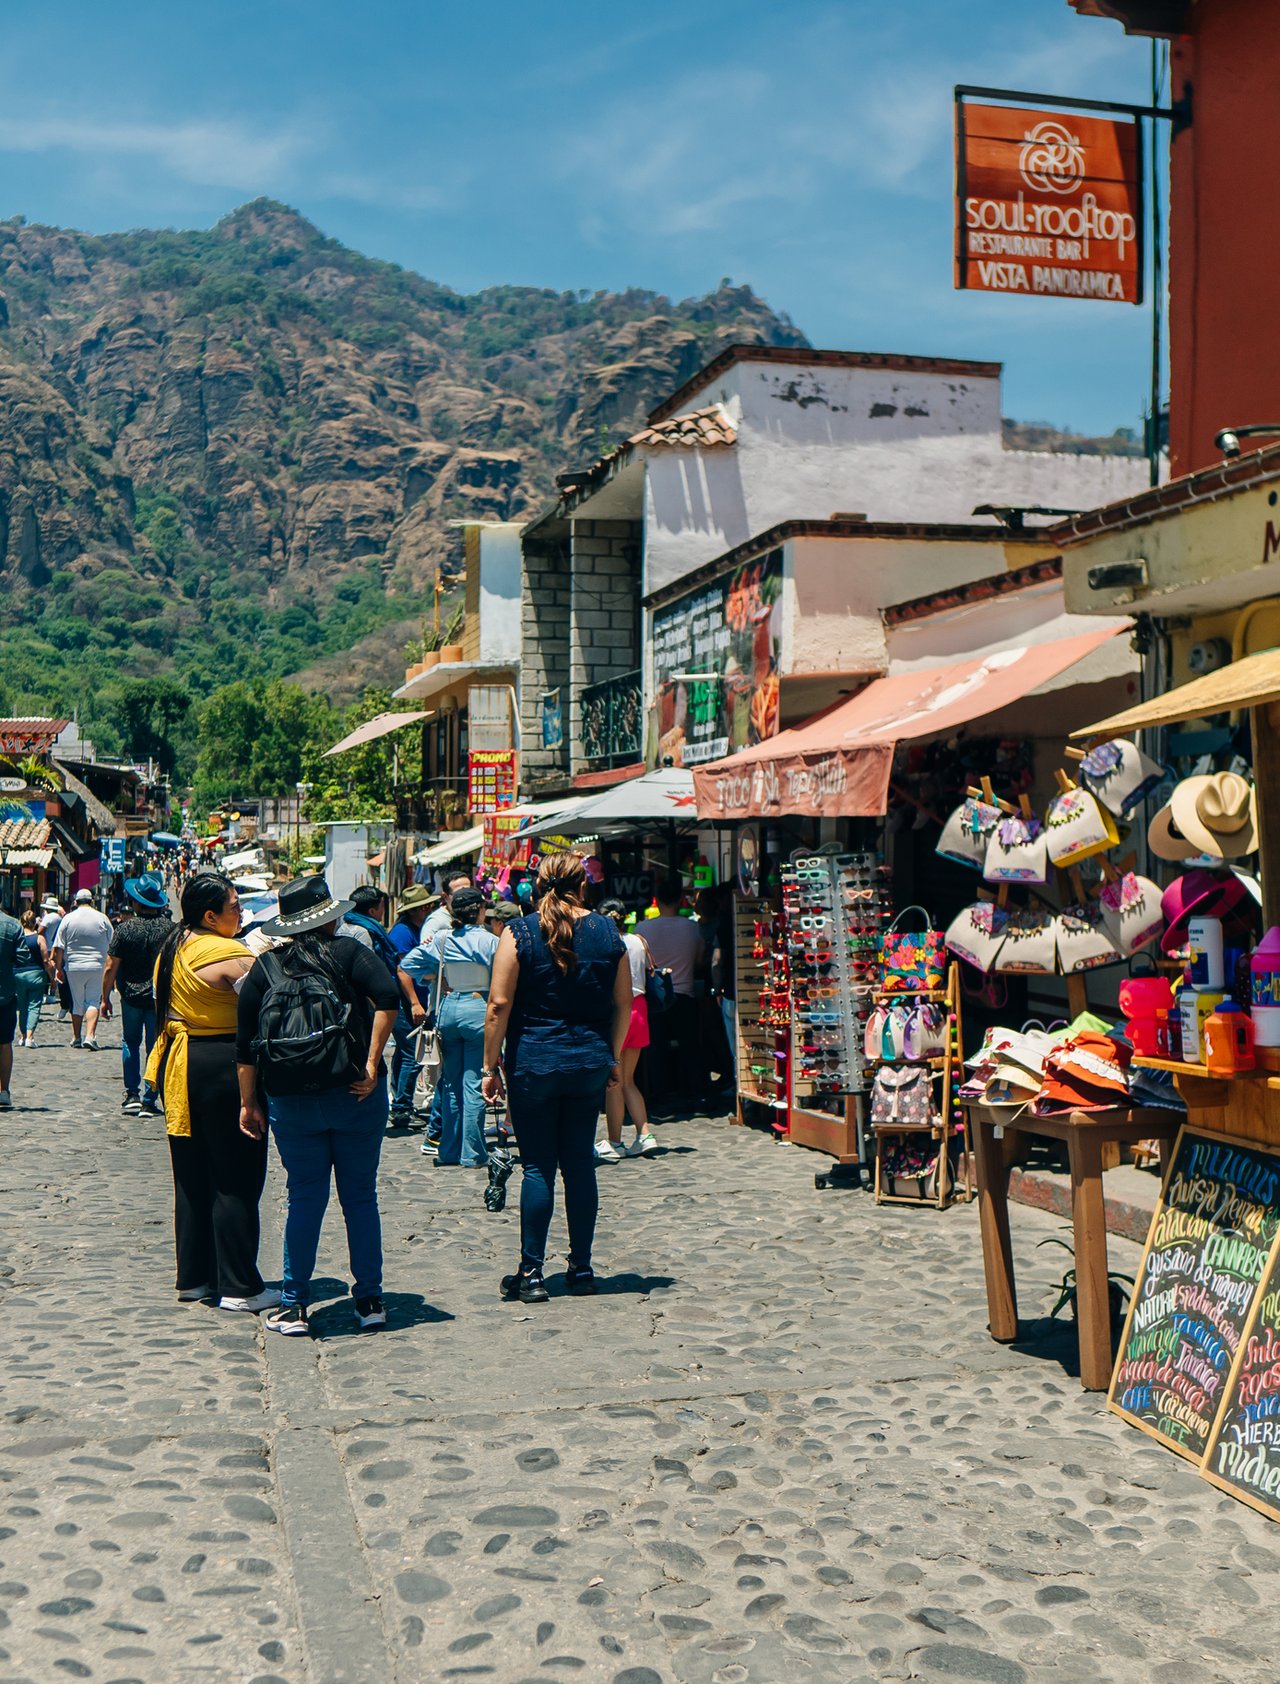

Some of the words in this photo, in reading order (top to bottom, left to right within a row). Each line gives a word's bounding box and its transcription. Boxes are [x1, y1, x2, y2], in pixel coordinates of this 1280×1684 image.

[969, 232, 1053, 258] RESTAURANTE
[1056, 238, 1082, 260] BAR
[977, 260, 1030, 290] VISTA
[614, 875, 650, 895] WC
[1145, 1247, 1196, 1297] gusano
[1193, 1249, 1213, 1286] de
[1204, 1233, 1269, 1281] CANNABIS
